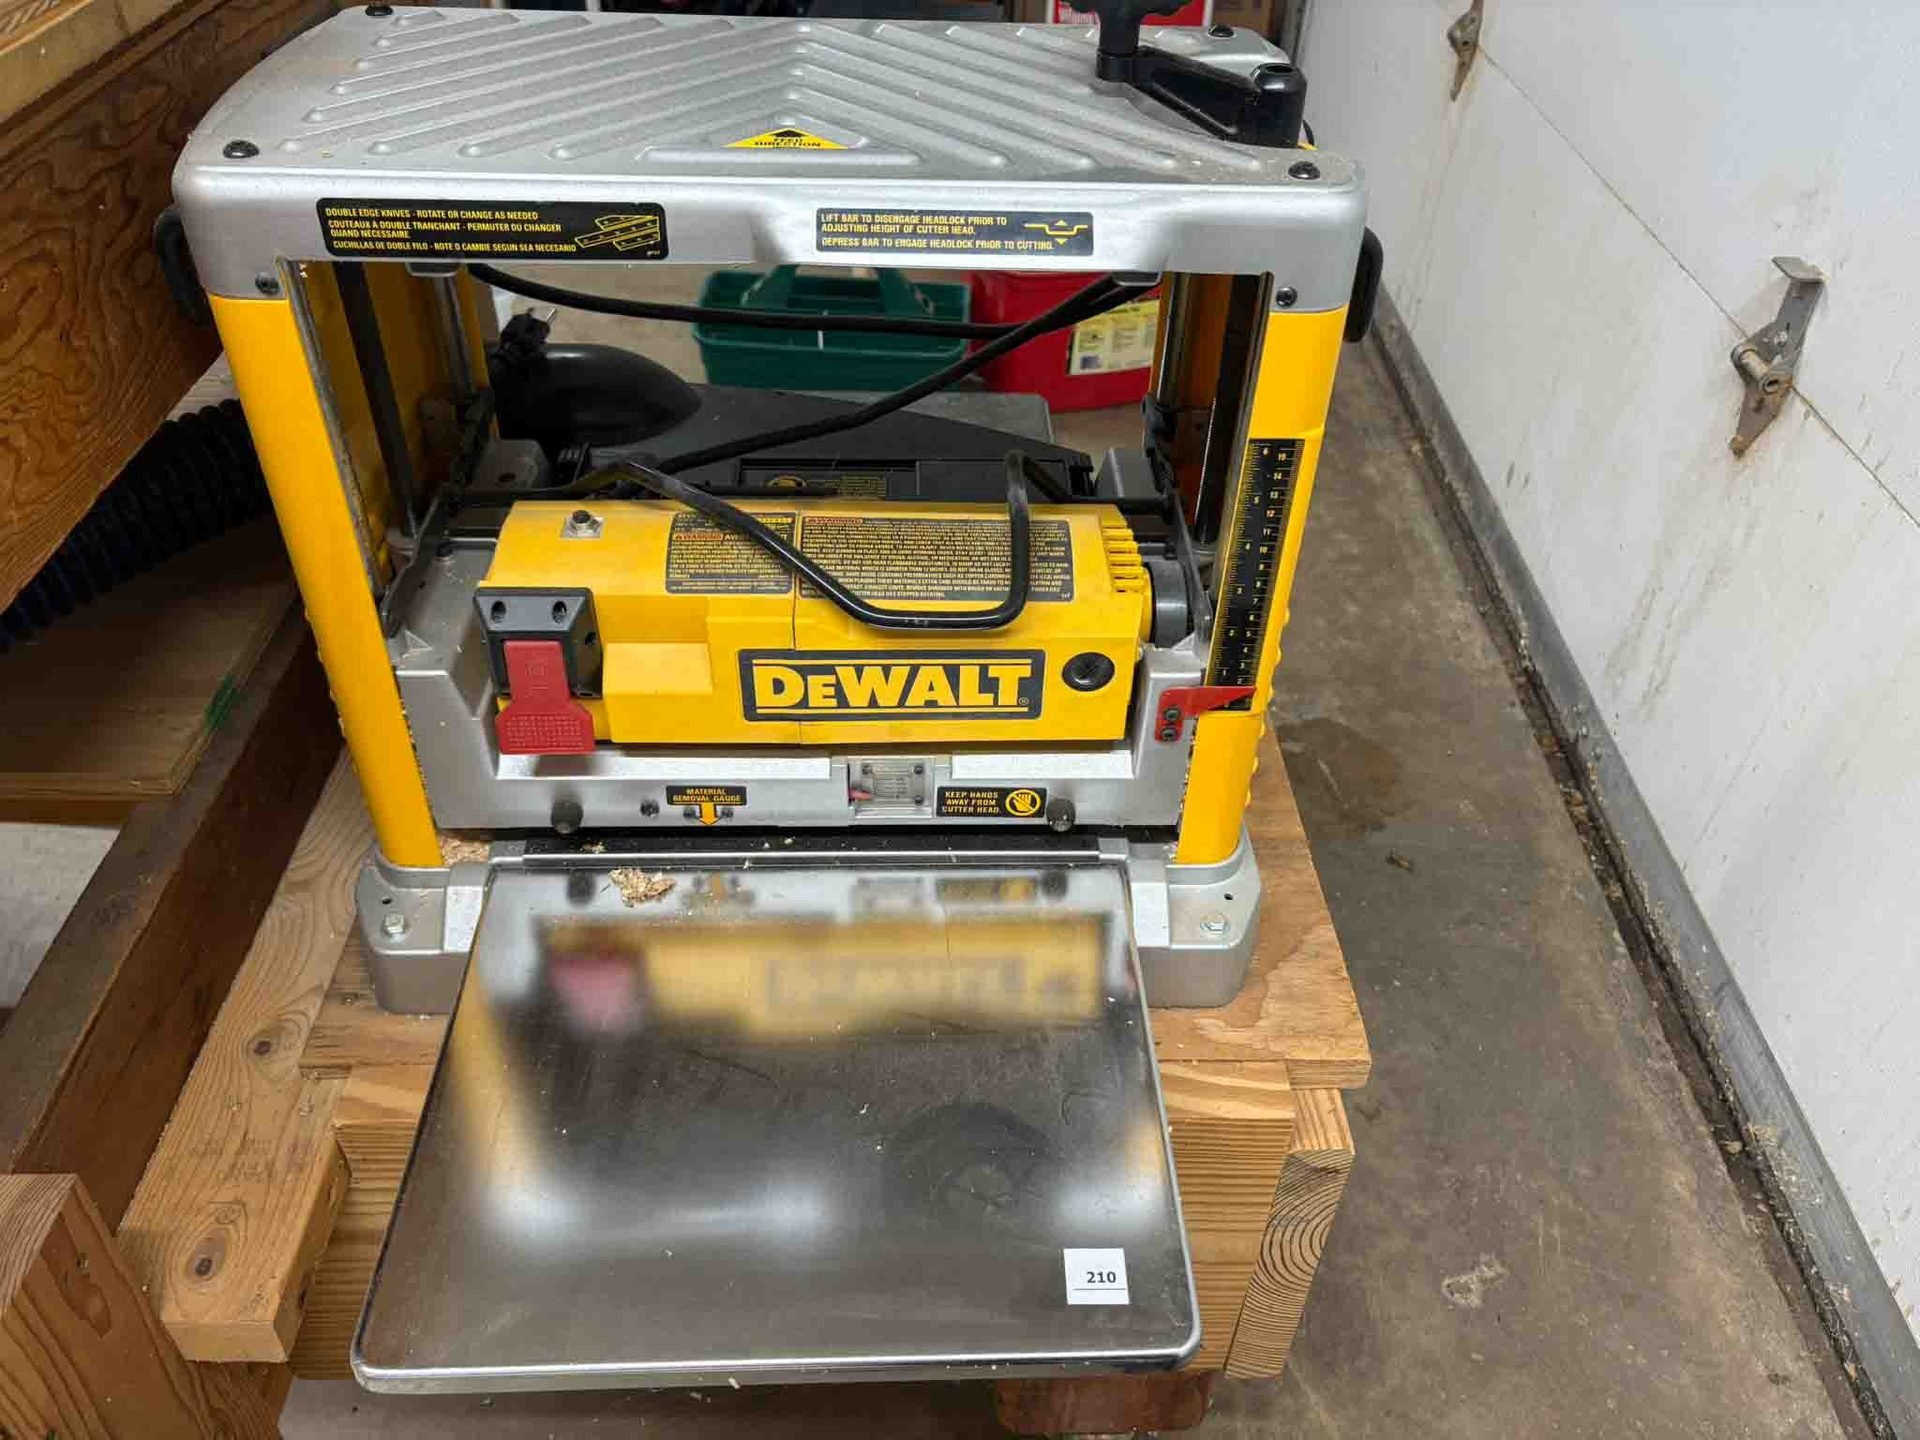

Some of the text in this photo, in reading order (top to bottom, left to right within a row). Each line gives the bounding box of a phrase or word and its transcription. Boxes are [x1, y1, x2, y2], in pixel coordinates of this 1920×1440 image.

[325, 208, 358, 217] DOUBLE
[359, 209, 380, 218] EDGE
[382, 209, 410, 218] KNIVES
[416, 210, 447, 219] ROTATE
[448, 210, 459, 219] OR
[460, 211, 493, 220] CHANGE
[494, 211, 506, 220] AS
[507, 211, 539, 220] NEEDED
[821, 214, 1007, 225] LIFT BAR TO DISENGAGE HEADLOCK PRIOR TO
[329, 220, 370, 229] COUTEAUX
[380, 221, 411, 230] DOUBLE
[413, 222, 461, 230] TRANCHANT
[467, 223, 510, 232] PERMUTER
[511, 223, 522, 231] OU
[524, 224, 562, 232] CHANGER
[821, 224, 868, 233] ADJUSTING
[870, 224, 900, 233] HEIGHT
[903, 225, 915, 233] OF
[916, 225, 949, 234] CUTTER
[331, 229, 360, 238] QUAND
[333, 241, 375, 250] CUCHILLAS
[375, 242, 385, 250] DE
[386, 242, 411, 250] DOBLE
[412, 242, 428, 251] FILO
[434, 243, 455, 251] ROTE
[519, 243, 534, 252] SEA
[535, 244, 577, 252] NECESARIO
[822, 238, 860, 246] DEPRESS
[862, 238, 879, 247] BAR
[882, 238, 892, 247] TO
[895, 239, 927, 248] ENGAGE
[929, 239, 974, 249] HEADLOCK
[976, 240, 1001, 249] PRIOR
[1004, 241, 1015, 249] TO
[1273, 472, 1282, 480] 14
[1266, 510, 1275, 518] 12
[1263, 528, 1271, 536] 11
[1259, 546, 1268, 554] 10
[1253, 597, 1259, 605] 7
[1246, 630, 1251, 638] 5
[1243, 646, 1248, 654] 4
[1086, 1271, 1117, 1283] 210
